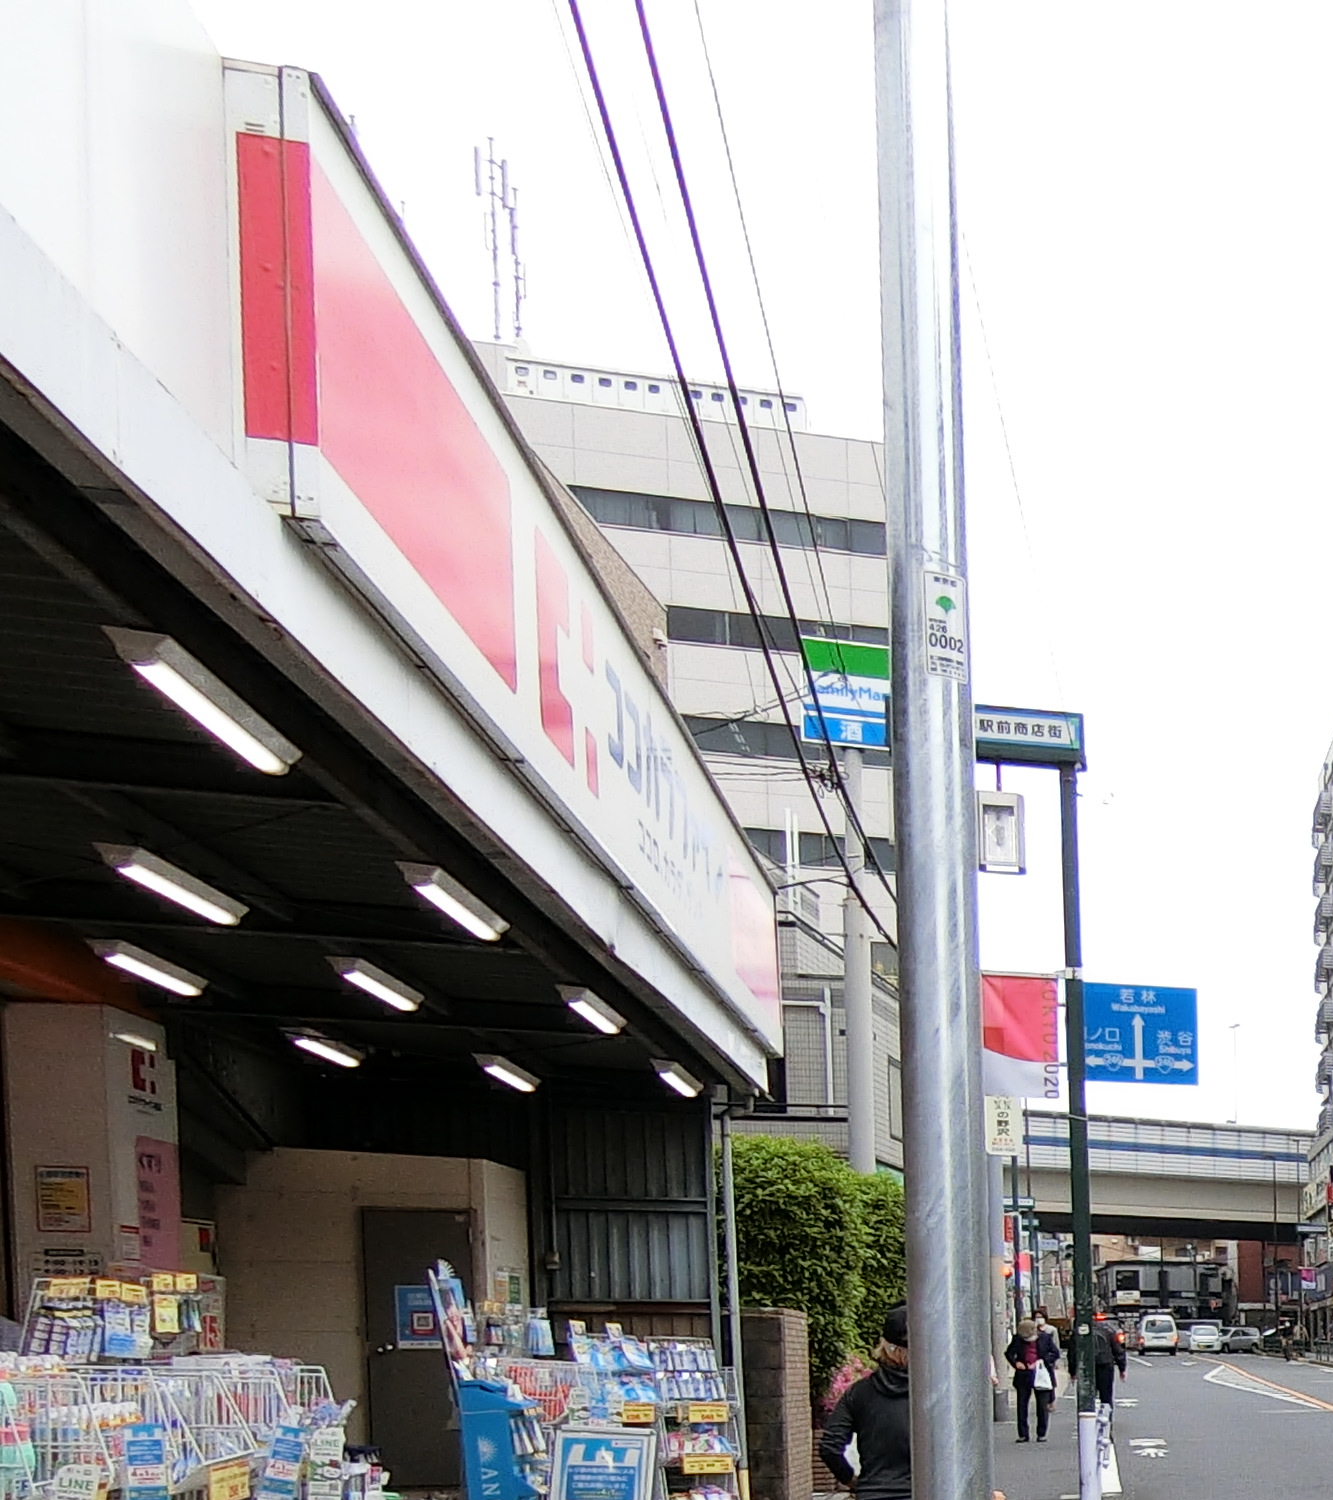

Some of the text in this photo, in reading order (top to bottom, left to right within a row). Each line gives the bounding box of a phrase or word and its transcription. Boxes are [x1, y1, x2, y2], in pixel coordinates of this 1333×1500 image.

[928, 633, 965, 654] 0002
[808, 683, 888, 702] amilyMar
[840, 719, 863, 743] 酒
[976, 718, 1062, 738] 駅前商店街
[1119, 988, 1157, 1004] 若林
[1084, 1027, 1120, 1042] ノ口
[1156, 1029, 1193, 1045] 渋谷
[1043, 1051, 1060, 1099] 2020
[59, 1477, 94, 1491] LINE
